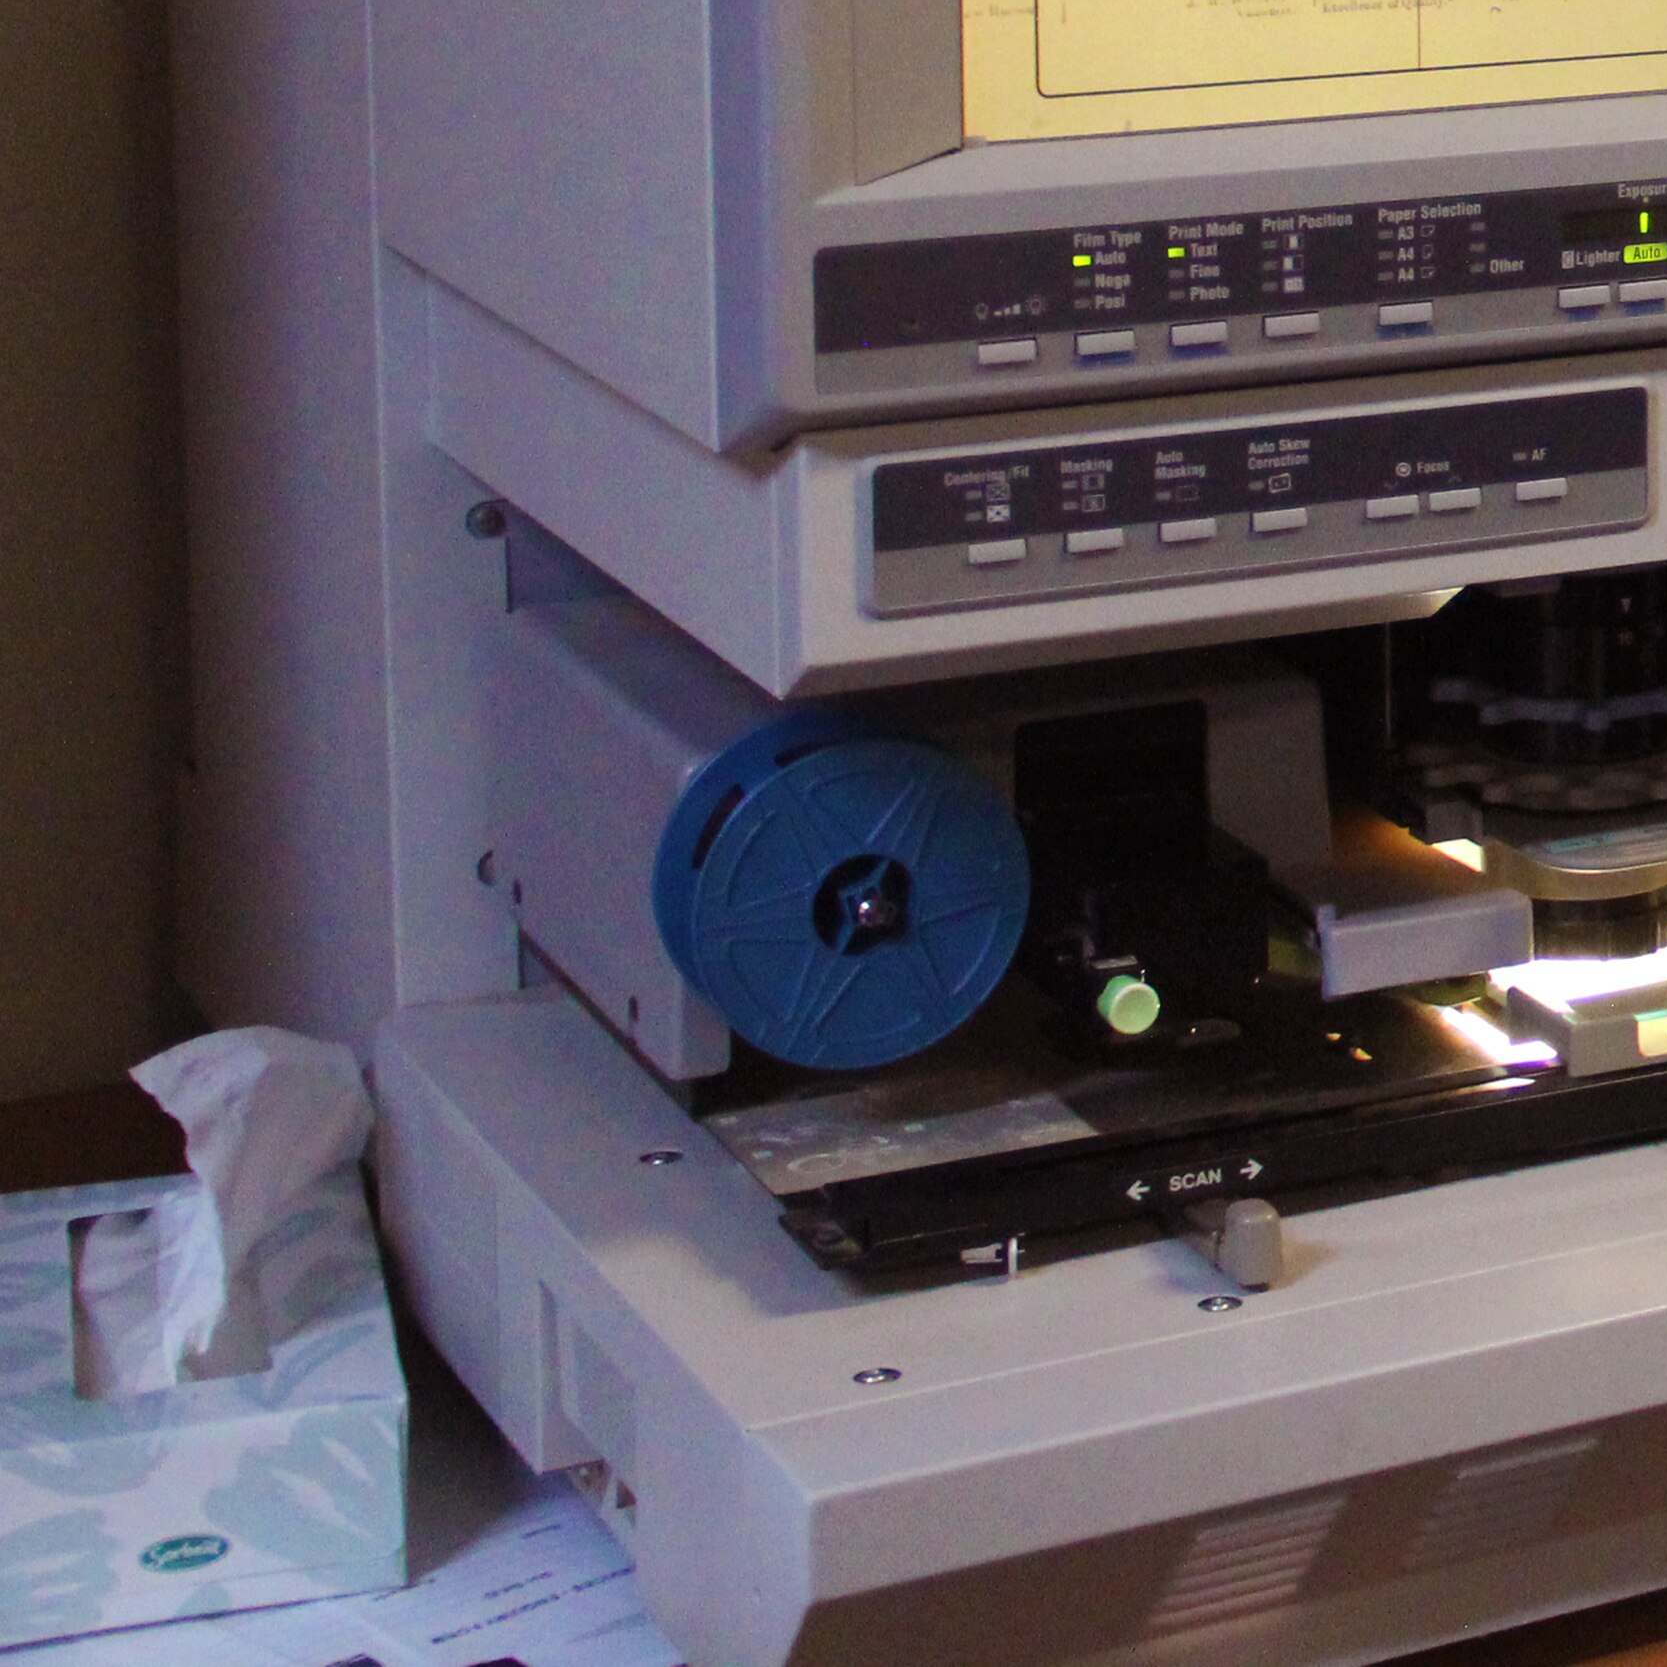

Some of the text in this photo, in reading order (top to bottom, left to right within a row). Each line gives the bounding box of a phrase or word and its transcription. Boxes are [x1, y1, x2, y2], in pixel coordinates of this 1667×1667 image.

[1378, 202, 1482, 224] Paper Selection
[1168, 220, 1245, 241] Print Mode
[1261, 212, 1354, 233] Print Position
[1073, 230, 1142, 249] Film Type
[1397, 225, 1415, 240] A3
[1190, 242, 1219, 257] Text
[1397, 247, 1415, 262] A4
[1575, 249, 1621, 268] Lighter
[1632, 246, 1662, 262] Auto
[1095, 250, 1127, 266] Auto
[1489, 258, 1525, 274] Other
[1190, 263, 1221, 279] Fine
[1397, 267, 1415, 282] A4
[1095, 272, 1132, 290] Nega
[1190, 285, 1230, 301] Photo
[1095, 294, 1126, 310] Posi
[1248, 438, 1311, 455] Auto Skew
[1156, 451, 1183, 465] Auto
[1248, 453, 1310, 471] Correction
[1531, 448, 1548, 462] AF
[1060, 457, 1113, 475] Masking
[1155, 463, 1206, 480] Masking
[1417, 460, 1450, 475] Focus
[1168, 1168, 1222, 1192] SCAN
